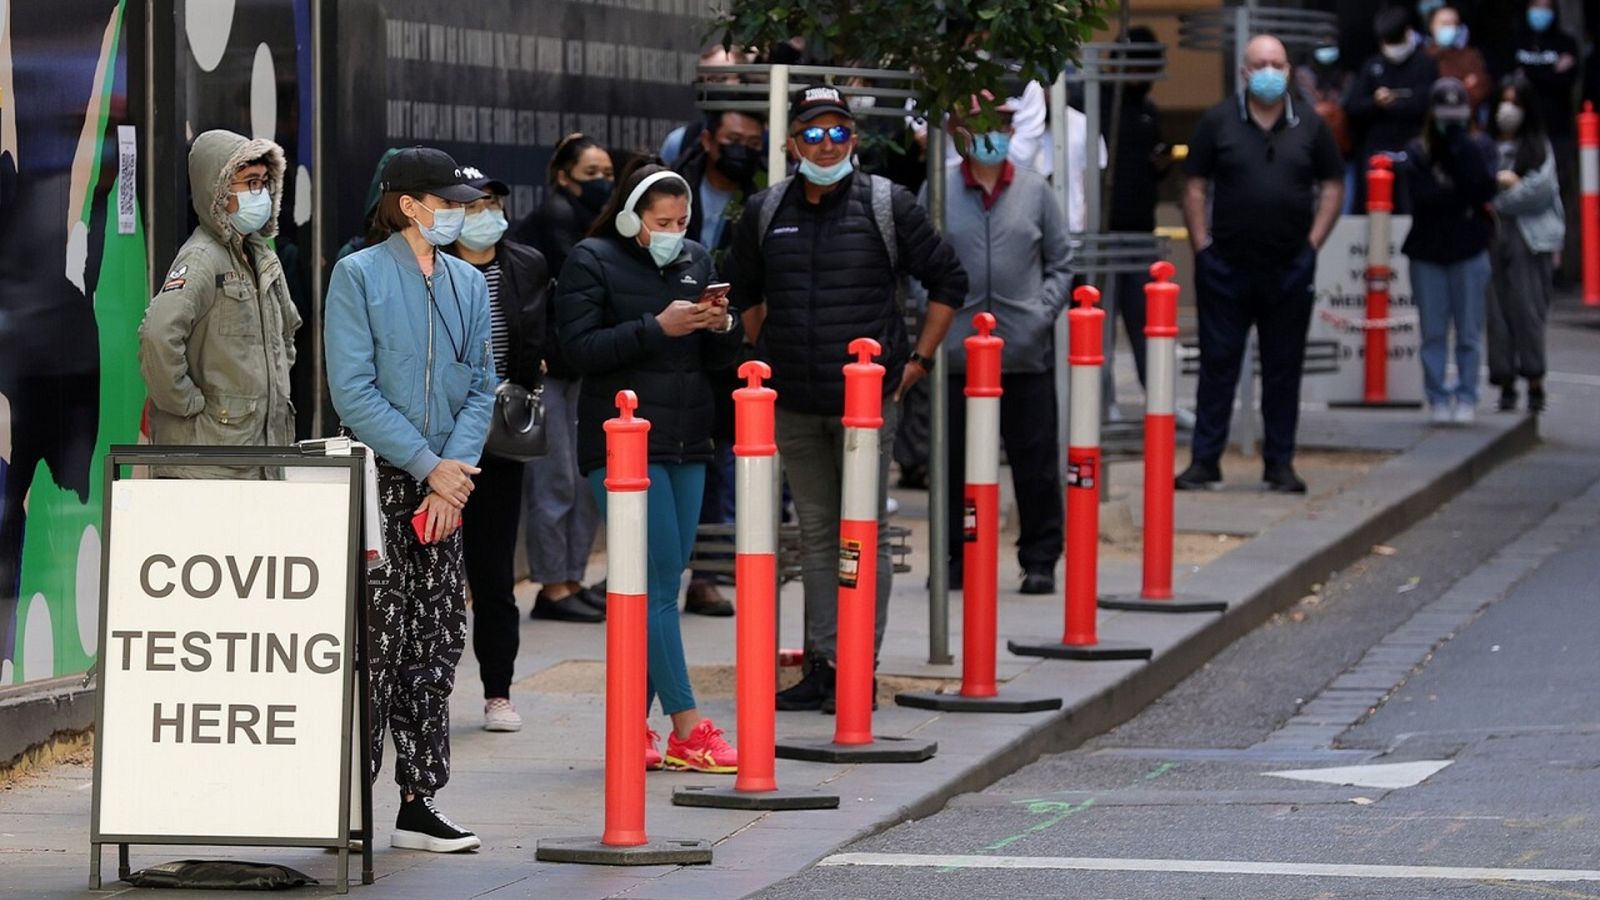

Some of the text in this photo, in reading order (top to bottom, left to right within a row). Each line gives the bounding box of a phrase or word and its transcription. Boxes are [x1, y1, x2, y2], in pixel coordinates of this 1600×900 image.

[140, 554, 319, 599] COVID
[112, 631, 340, 674] TESTING
[153, 703, 296, 745] HERE
